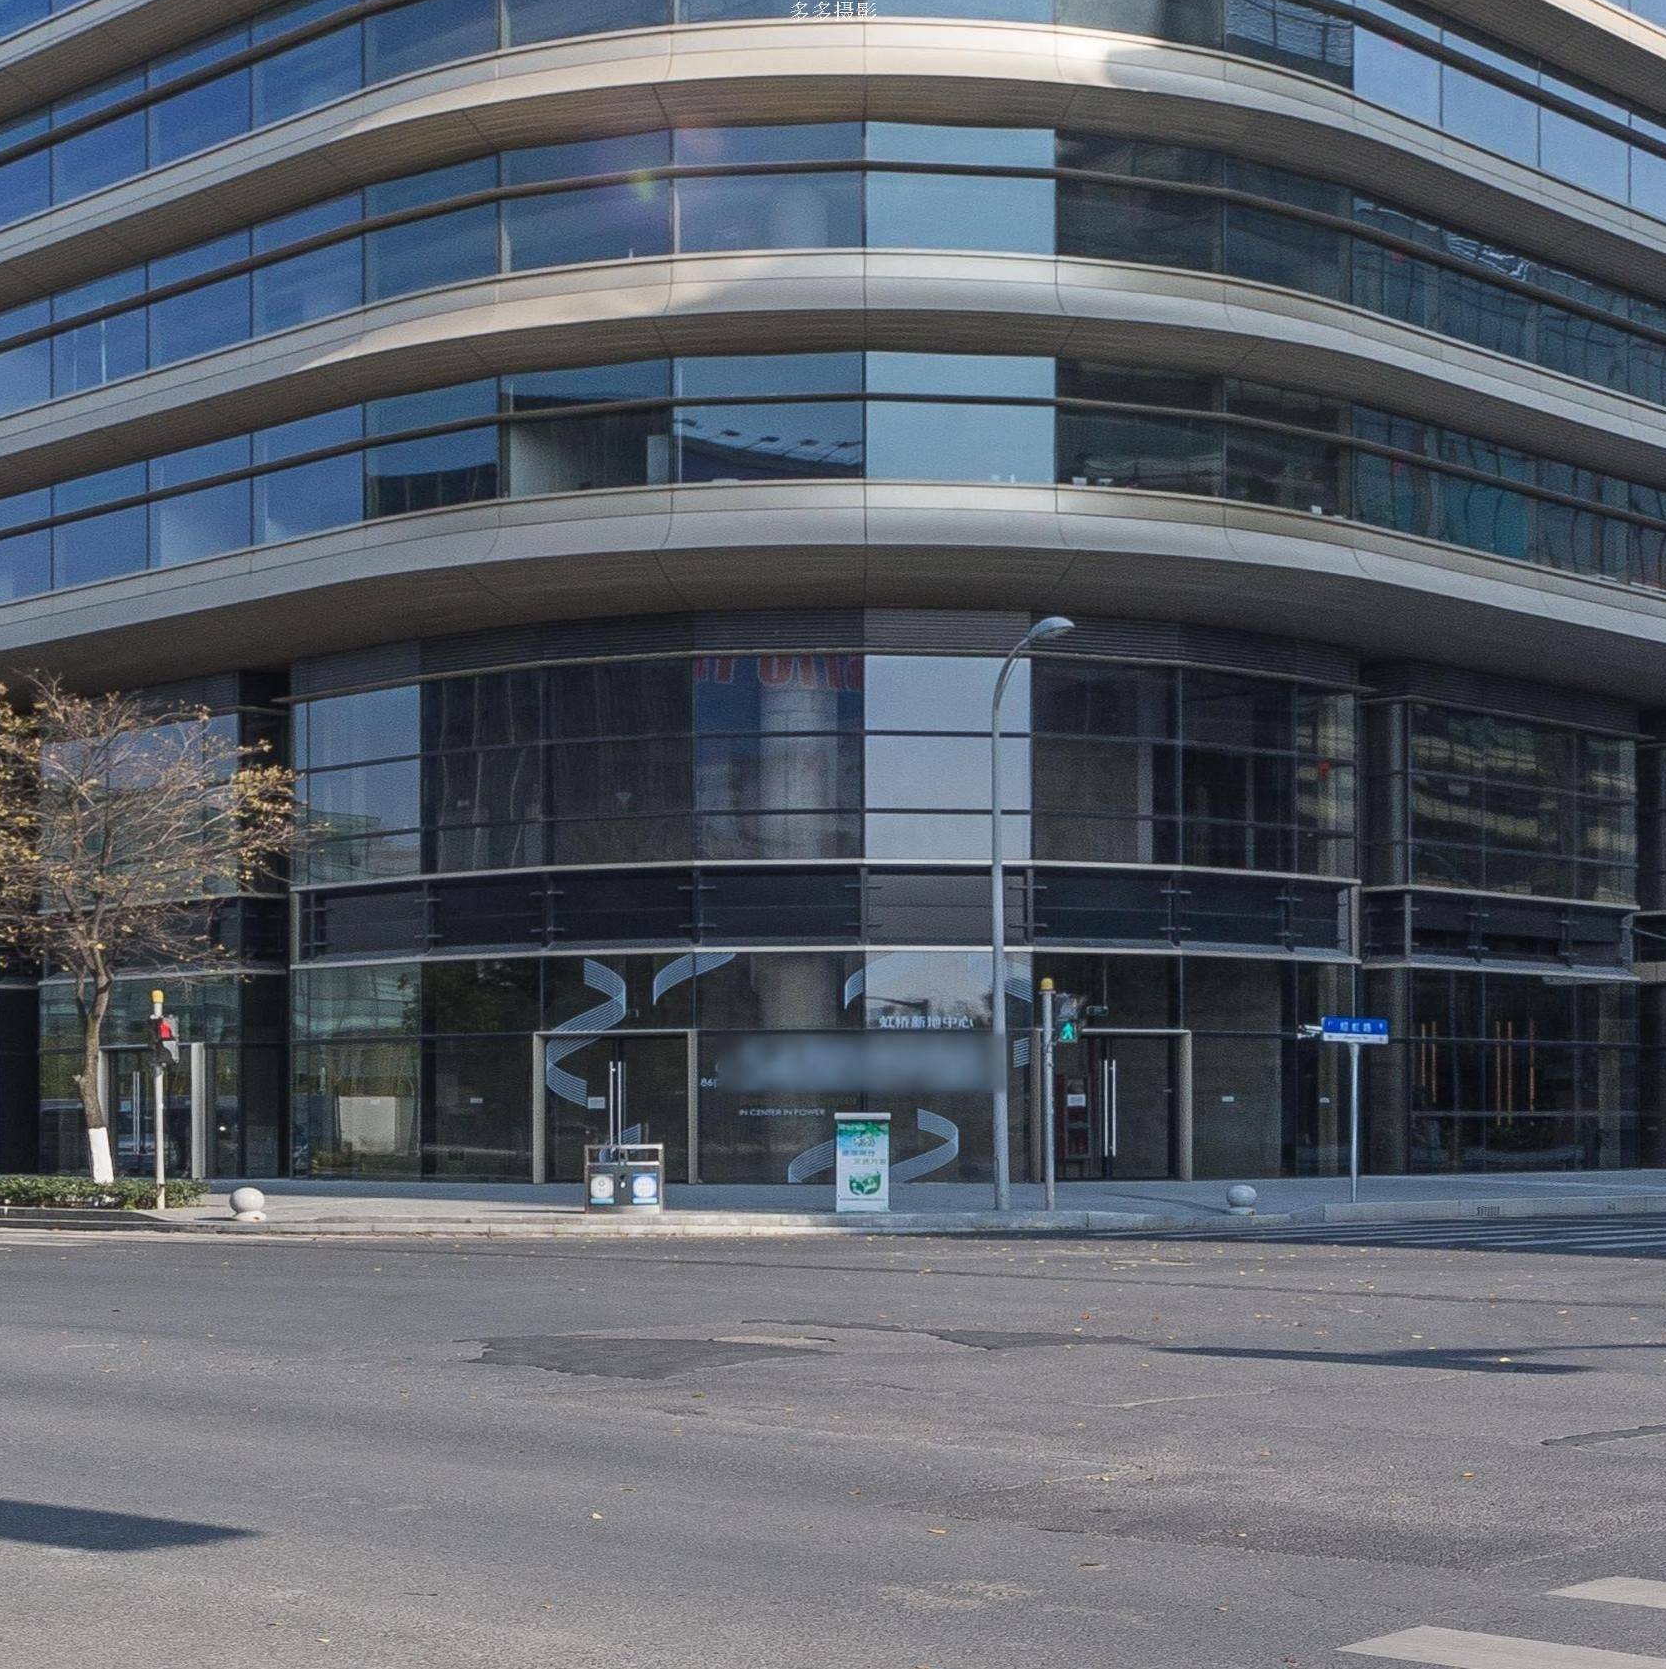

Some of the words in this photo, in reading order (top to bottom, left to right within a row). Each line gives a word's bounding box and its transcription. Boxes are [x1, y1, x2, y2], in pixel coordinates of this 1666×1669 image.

[878, 1014, 974, 1029] 虹桥新地中心
